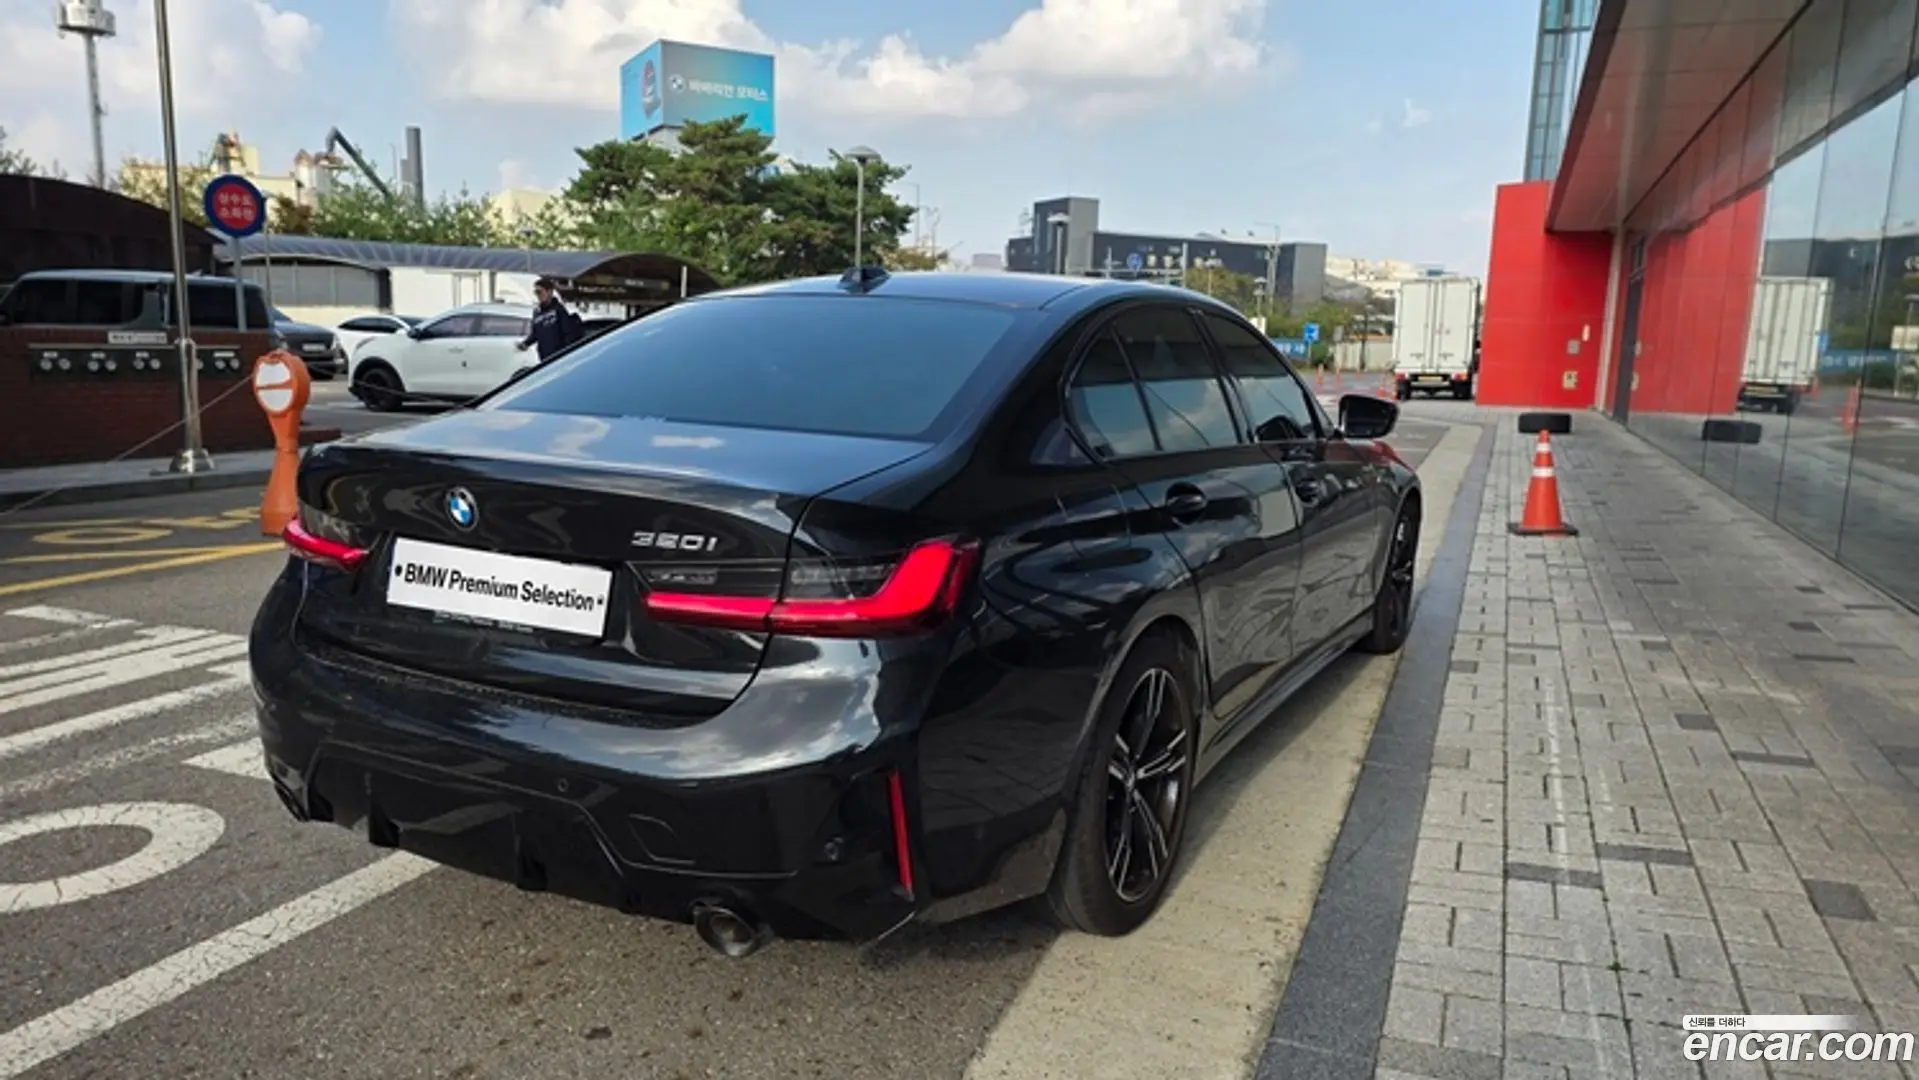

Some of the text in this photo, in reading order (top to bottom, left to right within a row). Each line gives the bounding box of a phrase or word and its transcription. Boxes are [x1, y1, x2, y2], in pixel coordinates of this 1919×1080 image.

[404, 563, 595, 611] BMW Premium Selection
